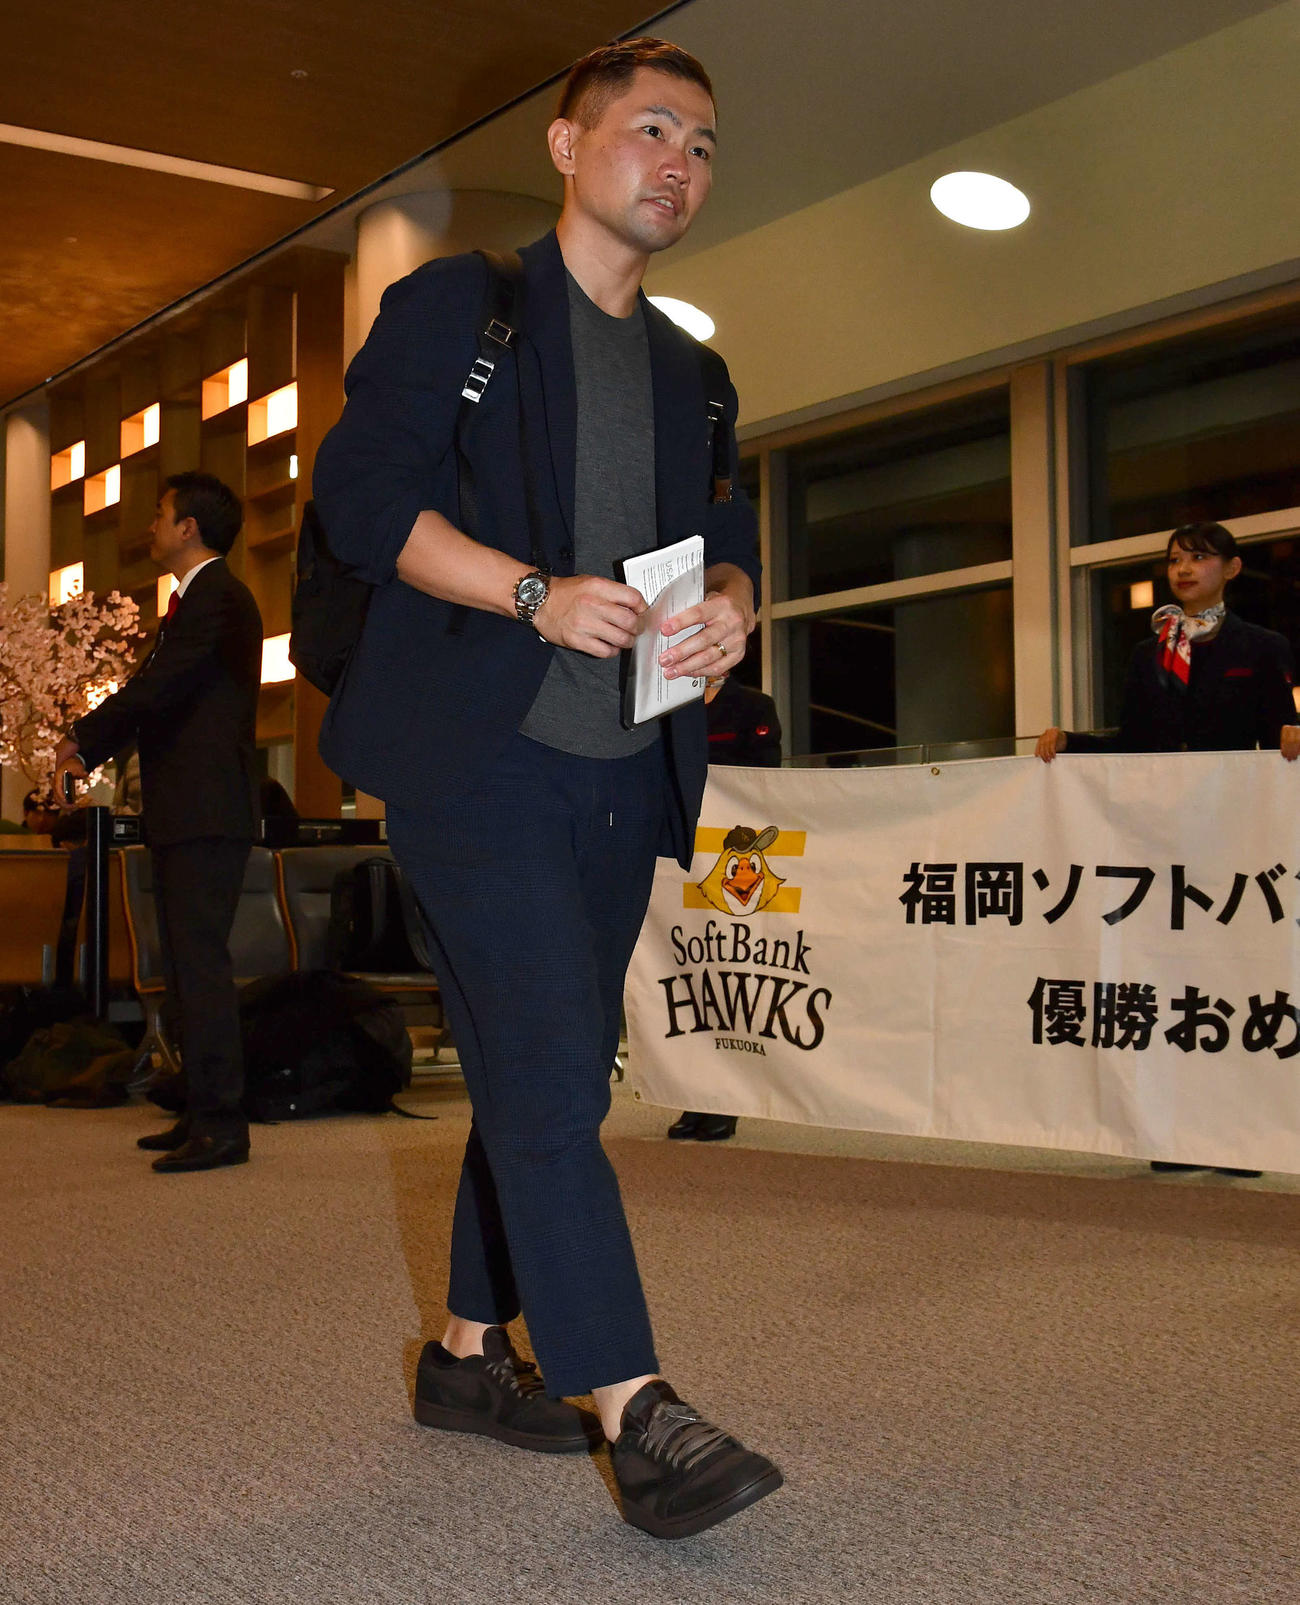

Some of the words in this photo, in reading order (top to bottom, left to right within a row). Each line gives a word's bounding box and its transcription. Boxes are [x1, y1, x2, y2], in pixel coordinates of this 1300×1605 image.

[665, 560, 673, 582] USA
[899, 862, 1300, 930] 福岡ソフトバ
[670, 920, 812, 975] SoftBank
[658, 968, 833, 1051] HAWKS
[1026, 976, 1300, 1059] 優勝おめ
[714, 1038, 767, 1056] FUKUOKA
